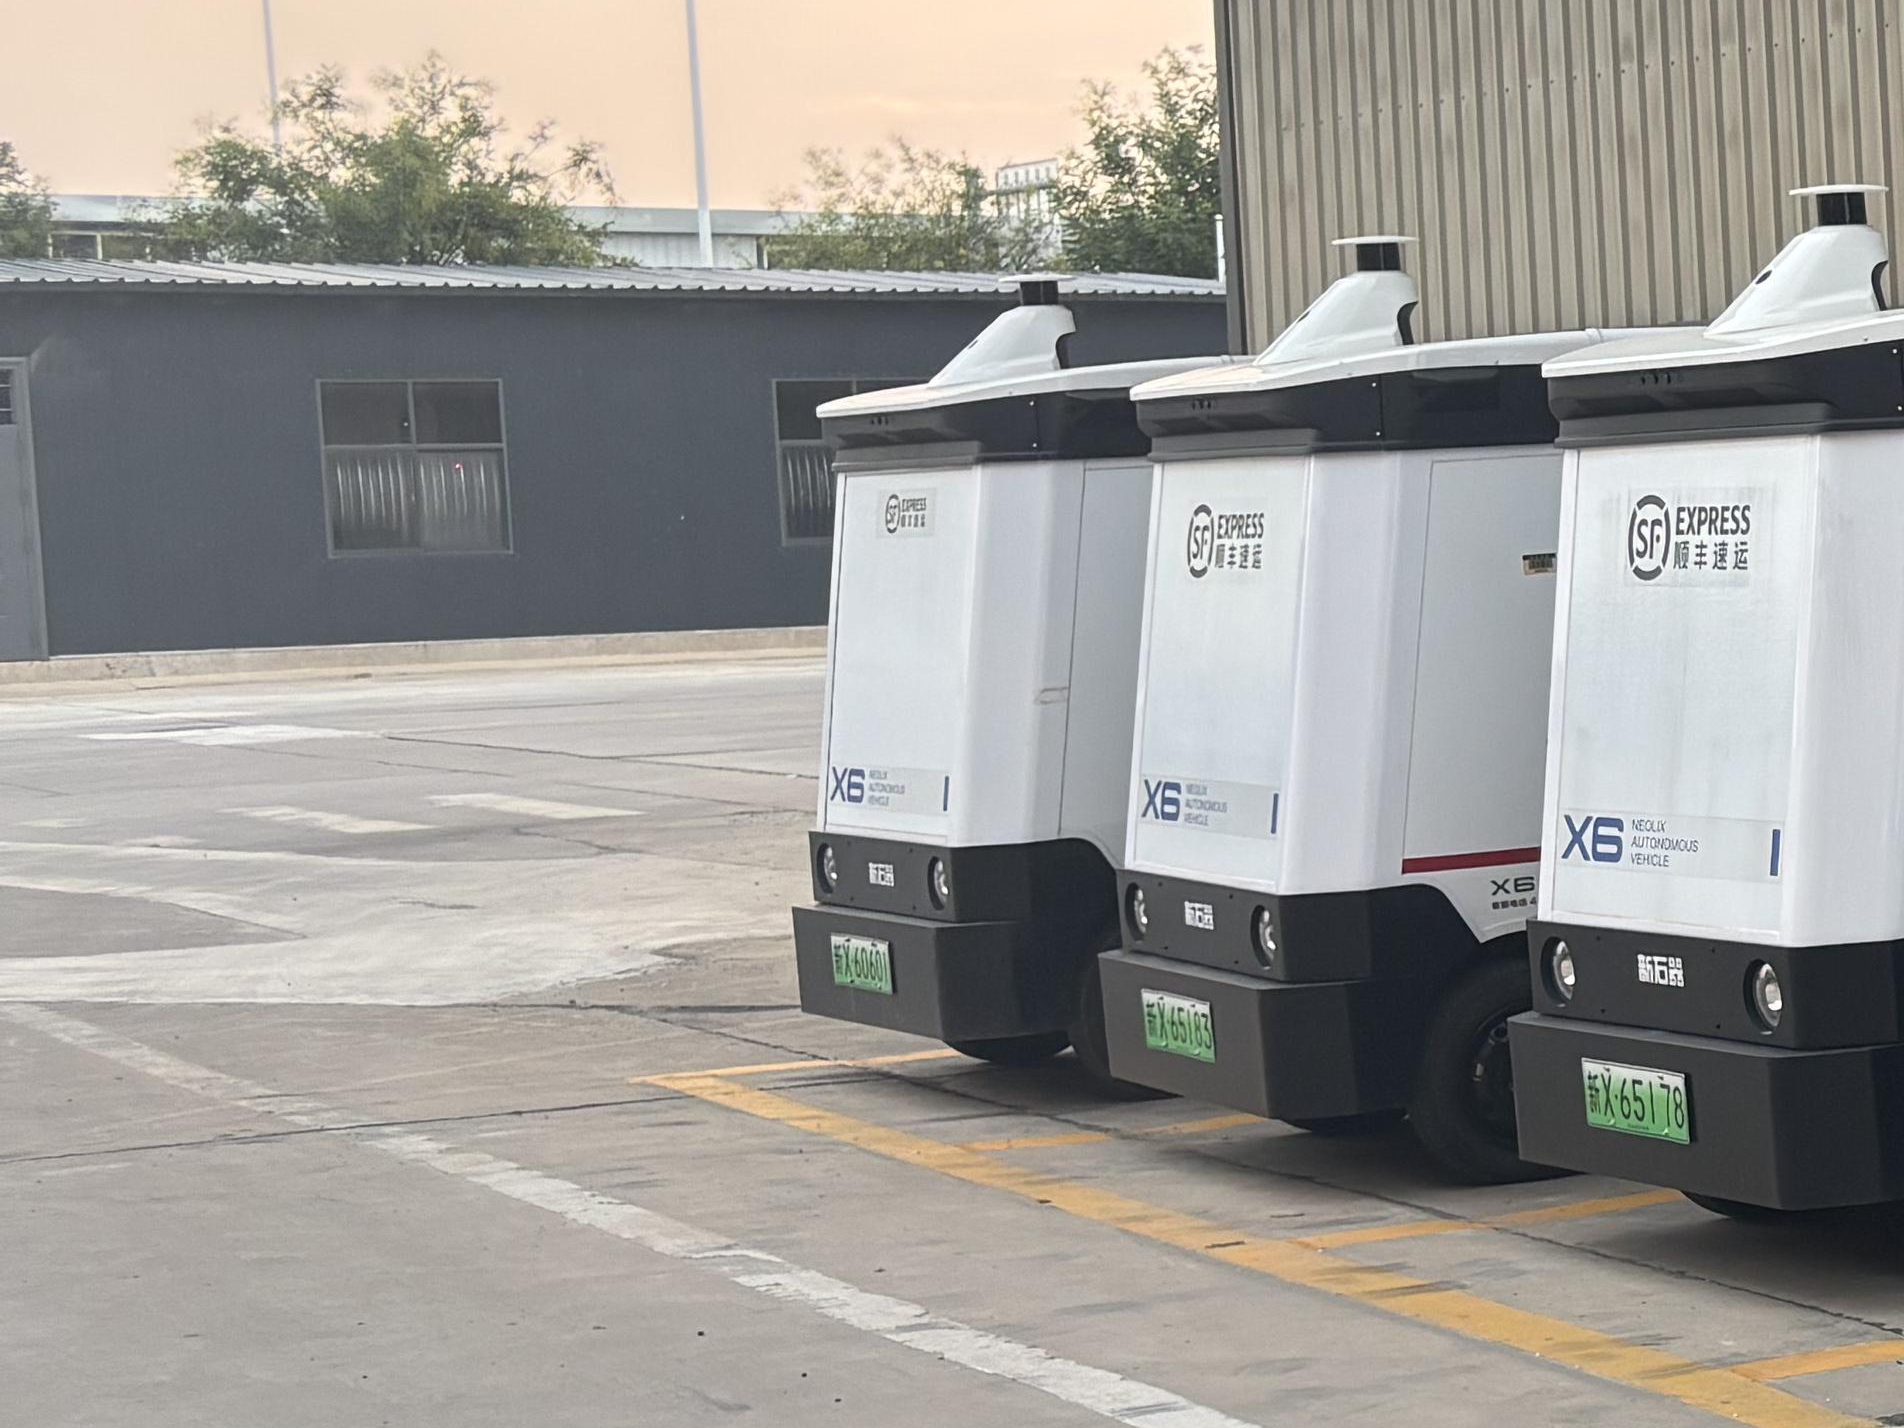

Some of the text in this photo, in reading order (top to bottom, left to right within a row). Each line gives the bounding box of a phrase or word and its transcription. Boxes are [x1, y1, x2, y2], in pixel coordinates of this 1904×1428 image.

[1216, 512, 1264, 539] EXPRESS
[1675, 504, 1751, 536] EXPRESS
[1673, 540, 1749, 570] 顺丰速运
[830, 766, 866, 804] X6
[1141, 779, 1182, 822] X6
[1561, 814, 1625, 863] X6
[1630, 835, 1699, 853] AUTONOMOUS
[1630, 852, 1670, 868] VEHICLE
[1489, 876, 1536, 896] X6
[1637, 954, 1685, 988] 新石器
